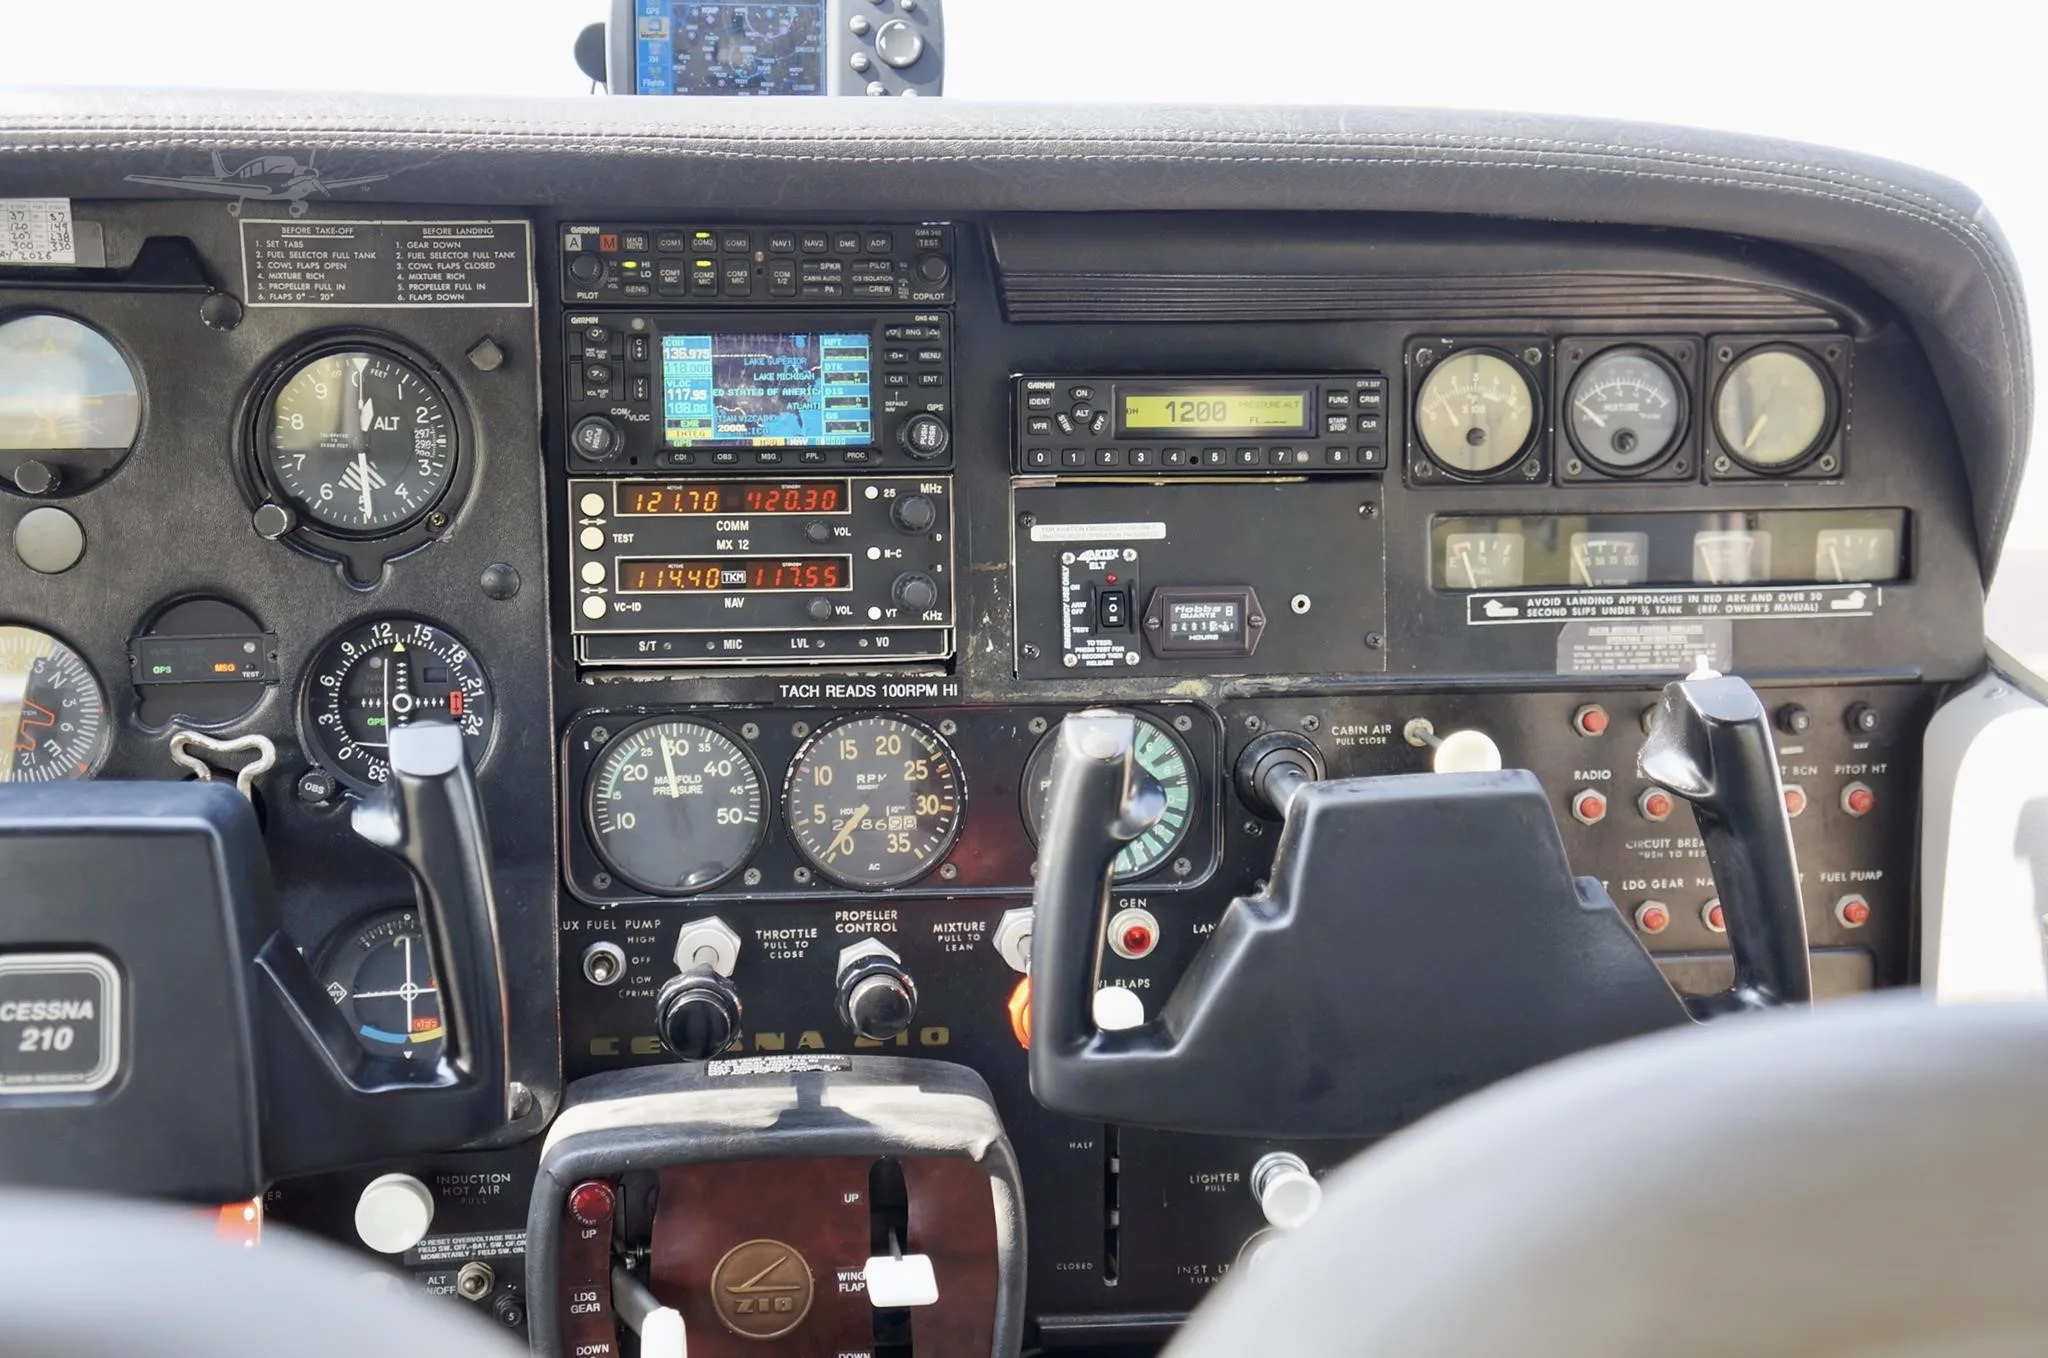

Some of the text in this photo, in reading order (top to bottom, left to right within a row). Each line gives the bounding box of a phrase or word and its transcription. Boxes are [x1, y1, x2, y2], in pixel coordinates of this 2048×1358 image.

[10, 231, 31, 240] 207
[281, 227, 354, 235] BEFORE TAKE-OFF
[422, 227, 494, 235] BEFORE LANDING
[10, 240, 34, 251] 300
[407, 241, 429, 249] GEAR
[433, 241, 461, 249] DOWN
[256, 251, 263, 259] 2.
[267, 251, 285, 259] FUEL
[289, 251, 328, 259] SELECTOR
[437, 262, 460, 270] FLAPS
[464, 262, 496, 270] CLOSED
[268, 272, 302, 280] MIXTURE
[754, 372, 815, 381] LAKE MICHIGAN
[1328, 396, 1348, 404] FUNC
[1166, 401, 1227, 422] 1200
[374, 416, 400, 431] ALT
[1033, 422, 1047, 430] VFR
[920, 483, 942, 494] MHz
[716, 520, 749, 531] COMM
[834, 527, 851, 536] VOL
[612, 533, 634, 543] TEST
[716, 539, 749, 550] MX 12
[1089, 561, 1106, 570] ELT
[724, 597, 744, 608] NAV
[1527, 592, 1823, 607] AVOID LANDING APPROACHES IN RED ARC AND OVER 30
[614, 602, 642, 612] VC-ID
[1527, 607, 1567, 617] SECOND
[1572, 607, 1597, 616] SLIPS
[1602, 606, 1636, 615] UNDER
[1656, 605, 1682, 614] TANK
[1698, 605, 1720, 615] (REF.
[1725, 604, 1769, 613] OWNER'S
[1774, 603, 1819, 613] MANUAL)
[922, 611, 943, 621] KHz
[371, 622, 393, 639] 12
[413, 624, 433, 641] 15
[638, 641, 657, 651] S/T
[723, 639, 743, 650] MIC
[791, 638, 809, 648] LVL
[153, 666, 172, 674] GPS
[214, 663, 235, 672] MSG
[780, 684, 958, 697] TACH READS 100RPM HI
[367, 718, 386, 726] GPS
[1331, 724, 1392, 735] CABIN AIR
[876, 735, 901, 755] 20
[1336, 736, 1386, 745] PULL CLOSE
[840, 740, 857, 760] 15
[623, 764, 648, 781] 20
[704, 760, 732, 777] 40
[904, 760, 928, 781] 25
[1834, 763, 1888, 775] PITOT HT
[1574, 770, 1611, 780] RADIO
[304, 782, 325, 795] OBS
[916, 795, 939, 815] 30
[717, 807, 743, 824] 50
[1820, 870, 1883, 882] FUEL PUMP
[1622, 878, 1684, 891] LDG GEAR
[1119, 898, 1147, 908] GEN
[835, 910, 898, 921] PROPELLER
[559, 919, 662, 931] UX FUEL PUMP
[835, 922, 898, 933] CONTROL
[933, 921, 987, 933] MIXTURE
[755, 928, 818, 940] THROTTLE
[938, 933, 981, 942] PULL TO
[627, 936, 656, 944] HIGH
[764, 941, 809, 950] PULL TO
[946, 943, 974, 951] LEAN
[770, 950, 805, 959] CLOSE
[631, 957, 651, 965] OFF
[0, 1000, 94, 1022] CESSNA
[19, 1026, 74, 1051] 210
[1069, 1141, 1094, 1149] HALF
[437, 1173, 511, 1185] INDUCTION
[1190, 1172, 1241, 1184] LIGHTER
[442, 1185, 500, 1196] HOT AIR
[844, 1193, 859, 1203] UP
[452, 1234, 504, 1244] OVERVOLTAGE
[581, 1229, 597, 1239] UP
[1056, 1262, 1094, 1271] CLOSED
[427, 1276, 446, 1285] ALT
[837, 1272, 865, 1281] WING
[839, 1282, 865, 1292] FLAP
[574, 1292, 597, 1302] LDG
[570, 1303, 601, 1314] GEAR
[576, 1344, 609, 1356] DOWN
